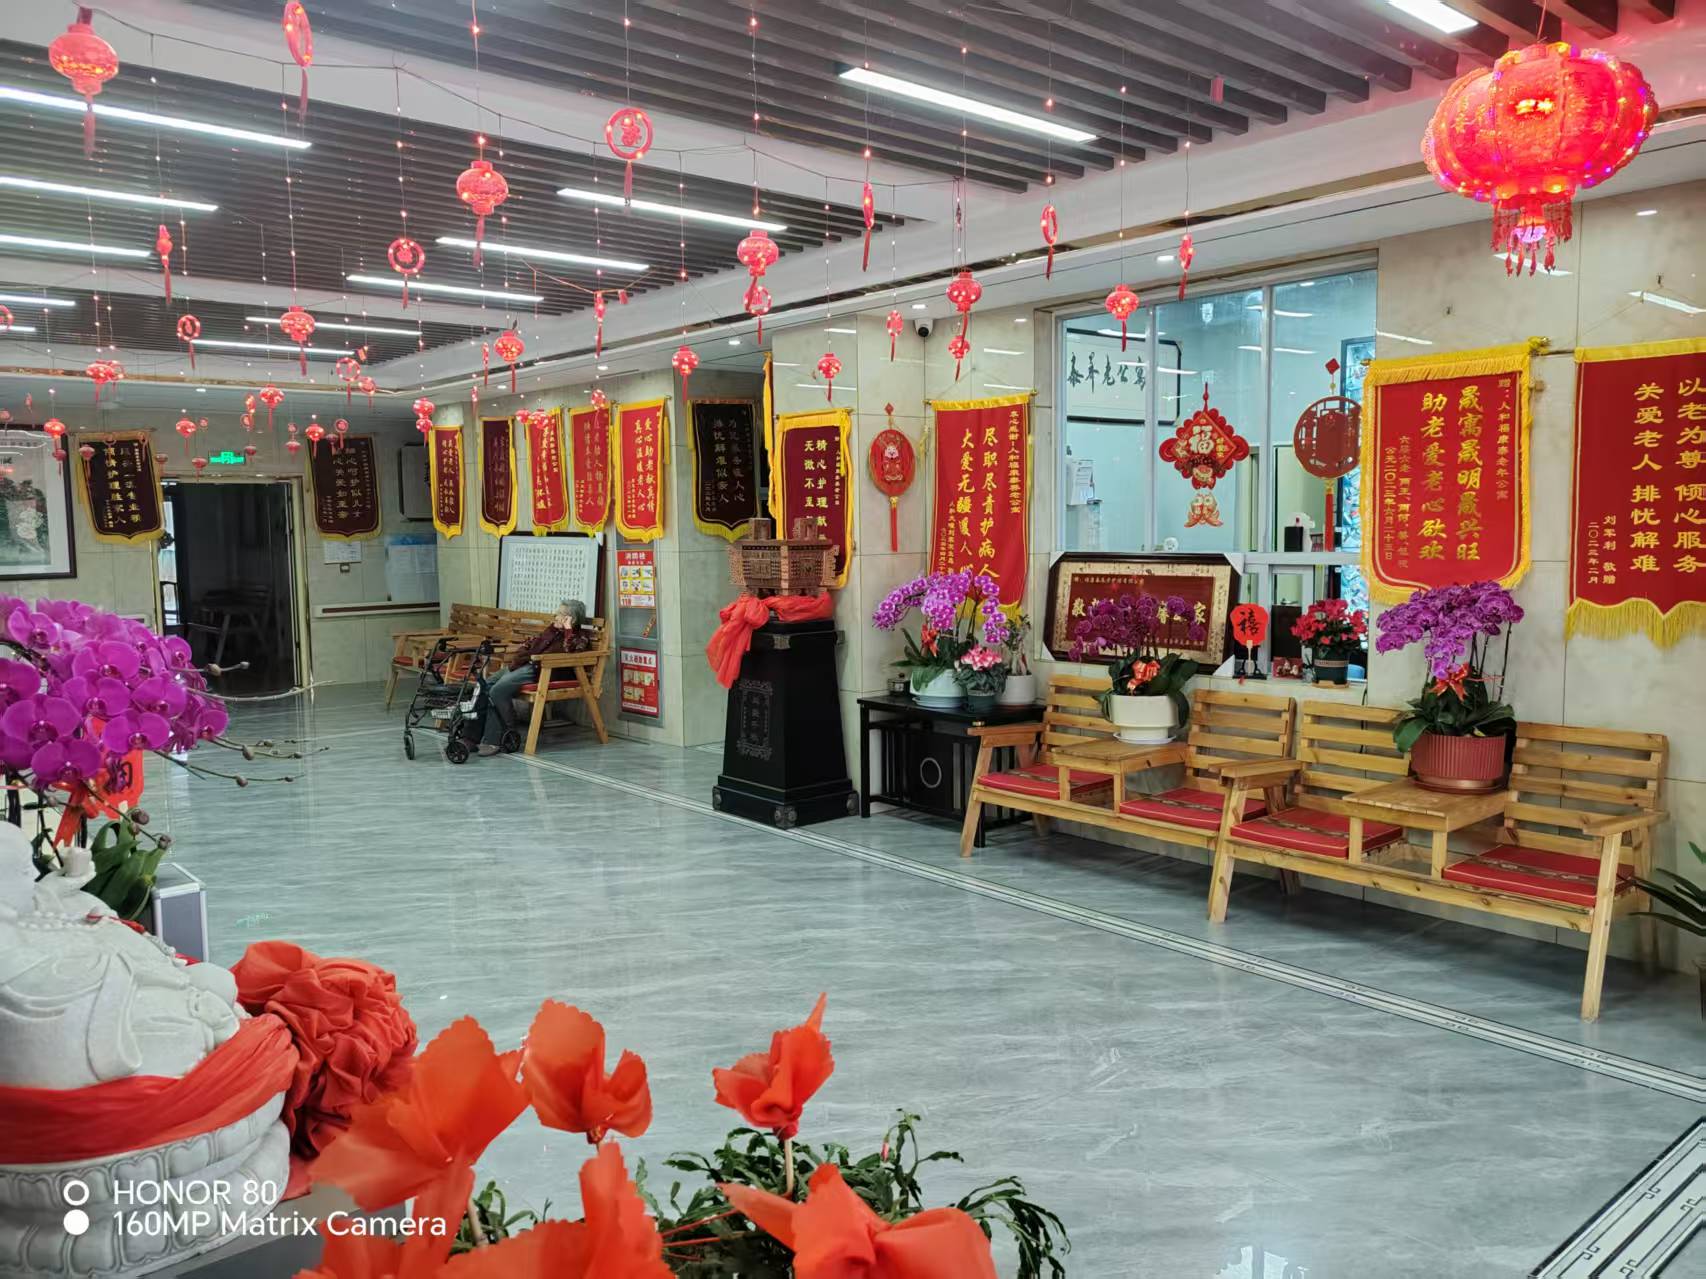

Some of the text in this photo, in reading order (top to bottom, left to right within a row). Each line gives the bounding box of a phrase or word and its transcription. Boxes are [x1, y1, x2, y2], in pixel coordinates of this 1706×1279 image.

[979, 427, 1000, 577] 尽职尽责护病人
[1189, 425, 1215, 455] 福
[1630, 382, 1665, 573] 关爱老人 排忧解难
[1673, 377, 1706, 574] 以老为尊 倾心服务
